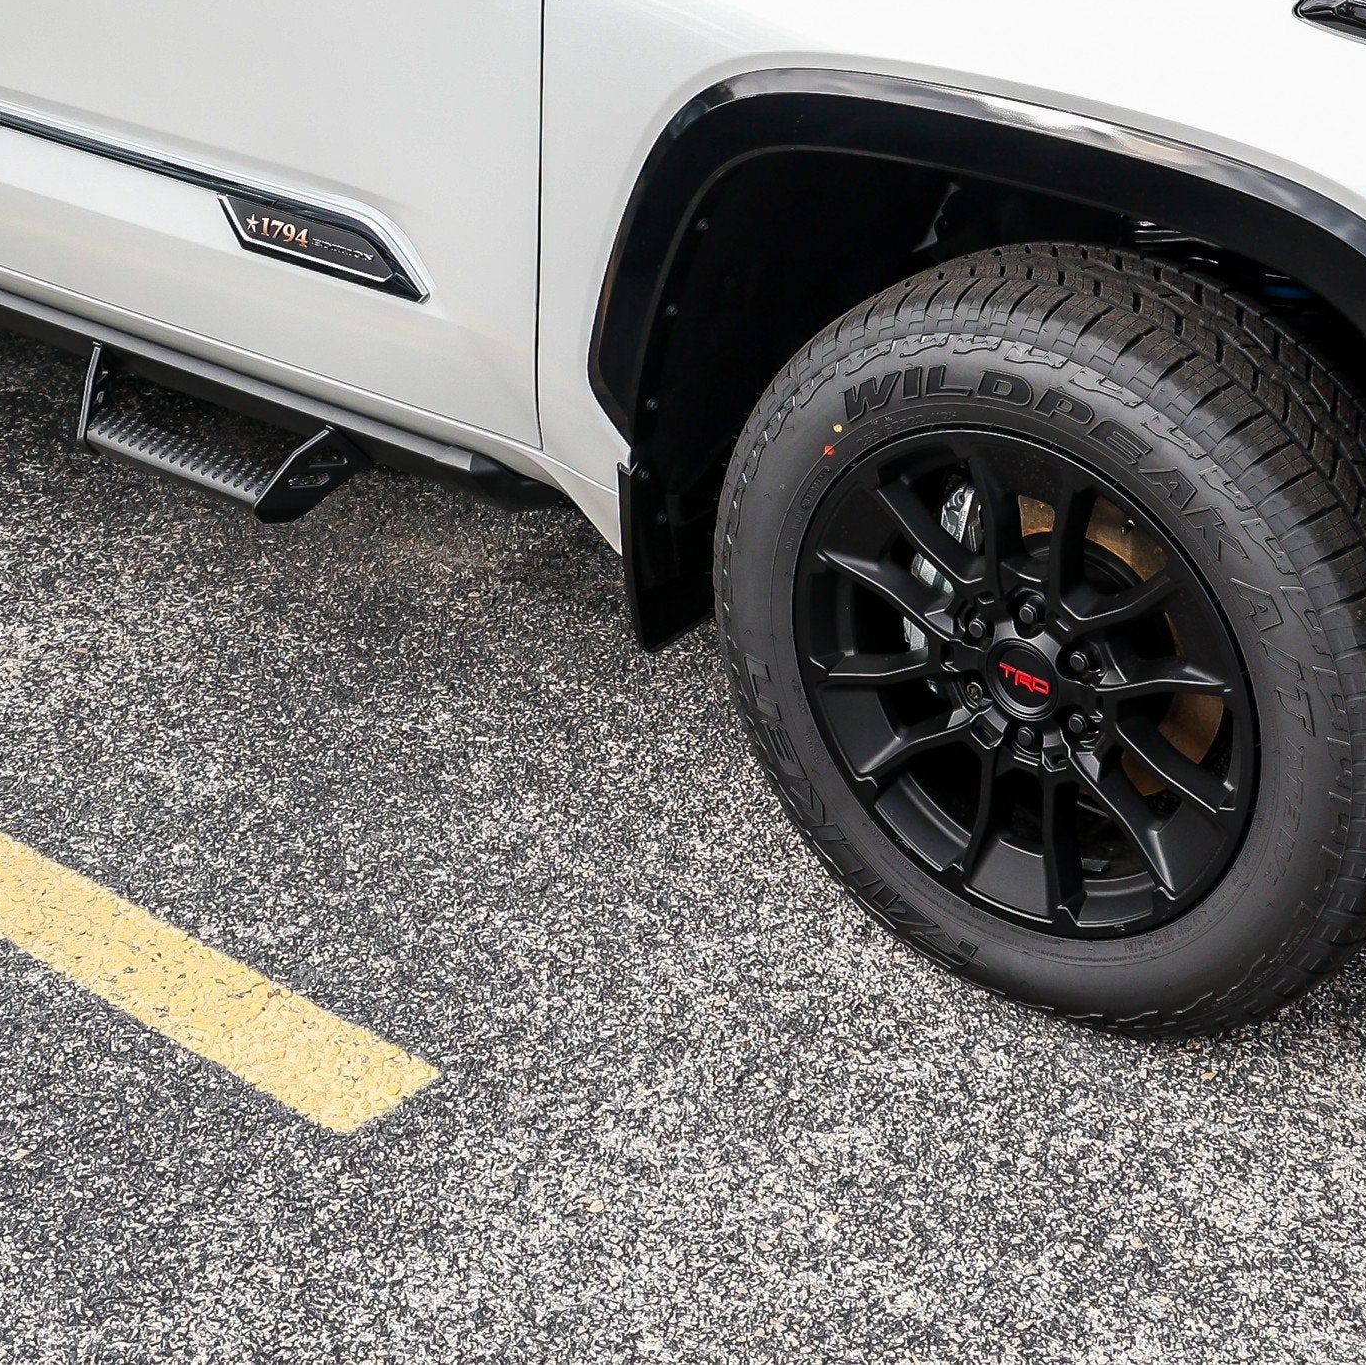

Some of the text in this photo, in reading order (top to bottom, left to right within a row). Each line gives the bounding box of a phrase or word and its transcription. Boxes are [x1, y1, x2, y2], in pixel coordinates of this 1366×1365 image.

[260, 217, 375, 262] 1794 EDITION
[838, 363, 1251, 563] WILDPEAK
[998, 661, 1051, 695] TRD
[743, 654, 988, 969] FALKEN
